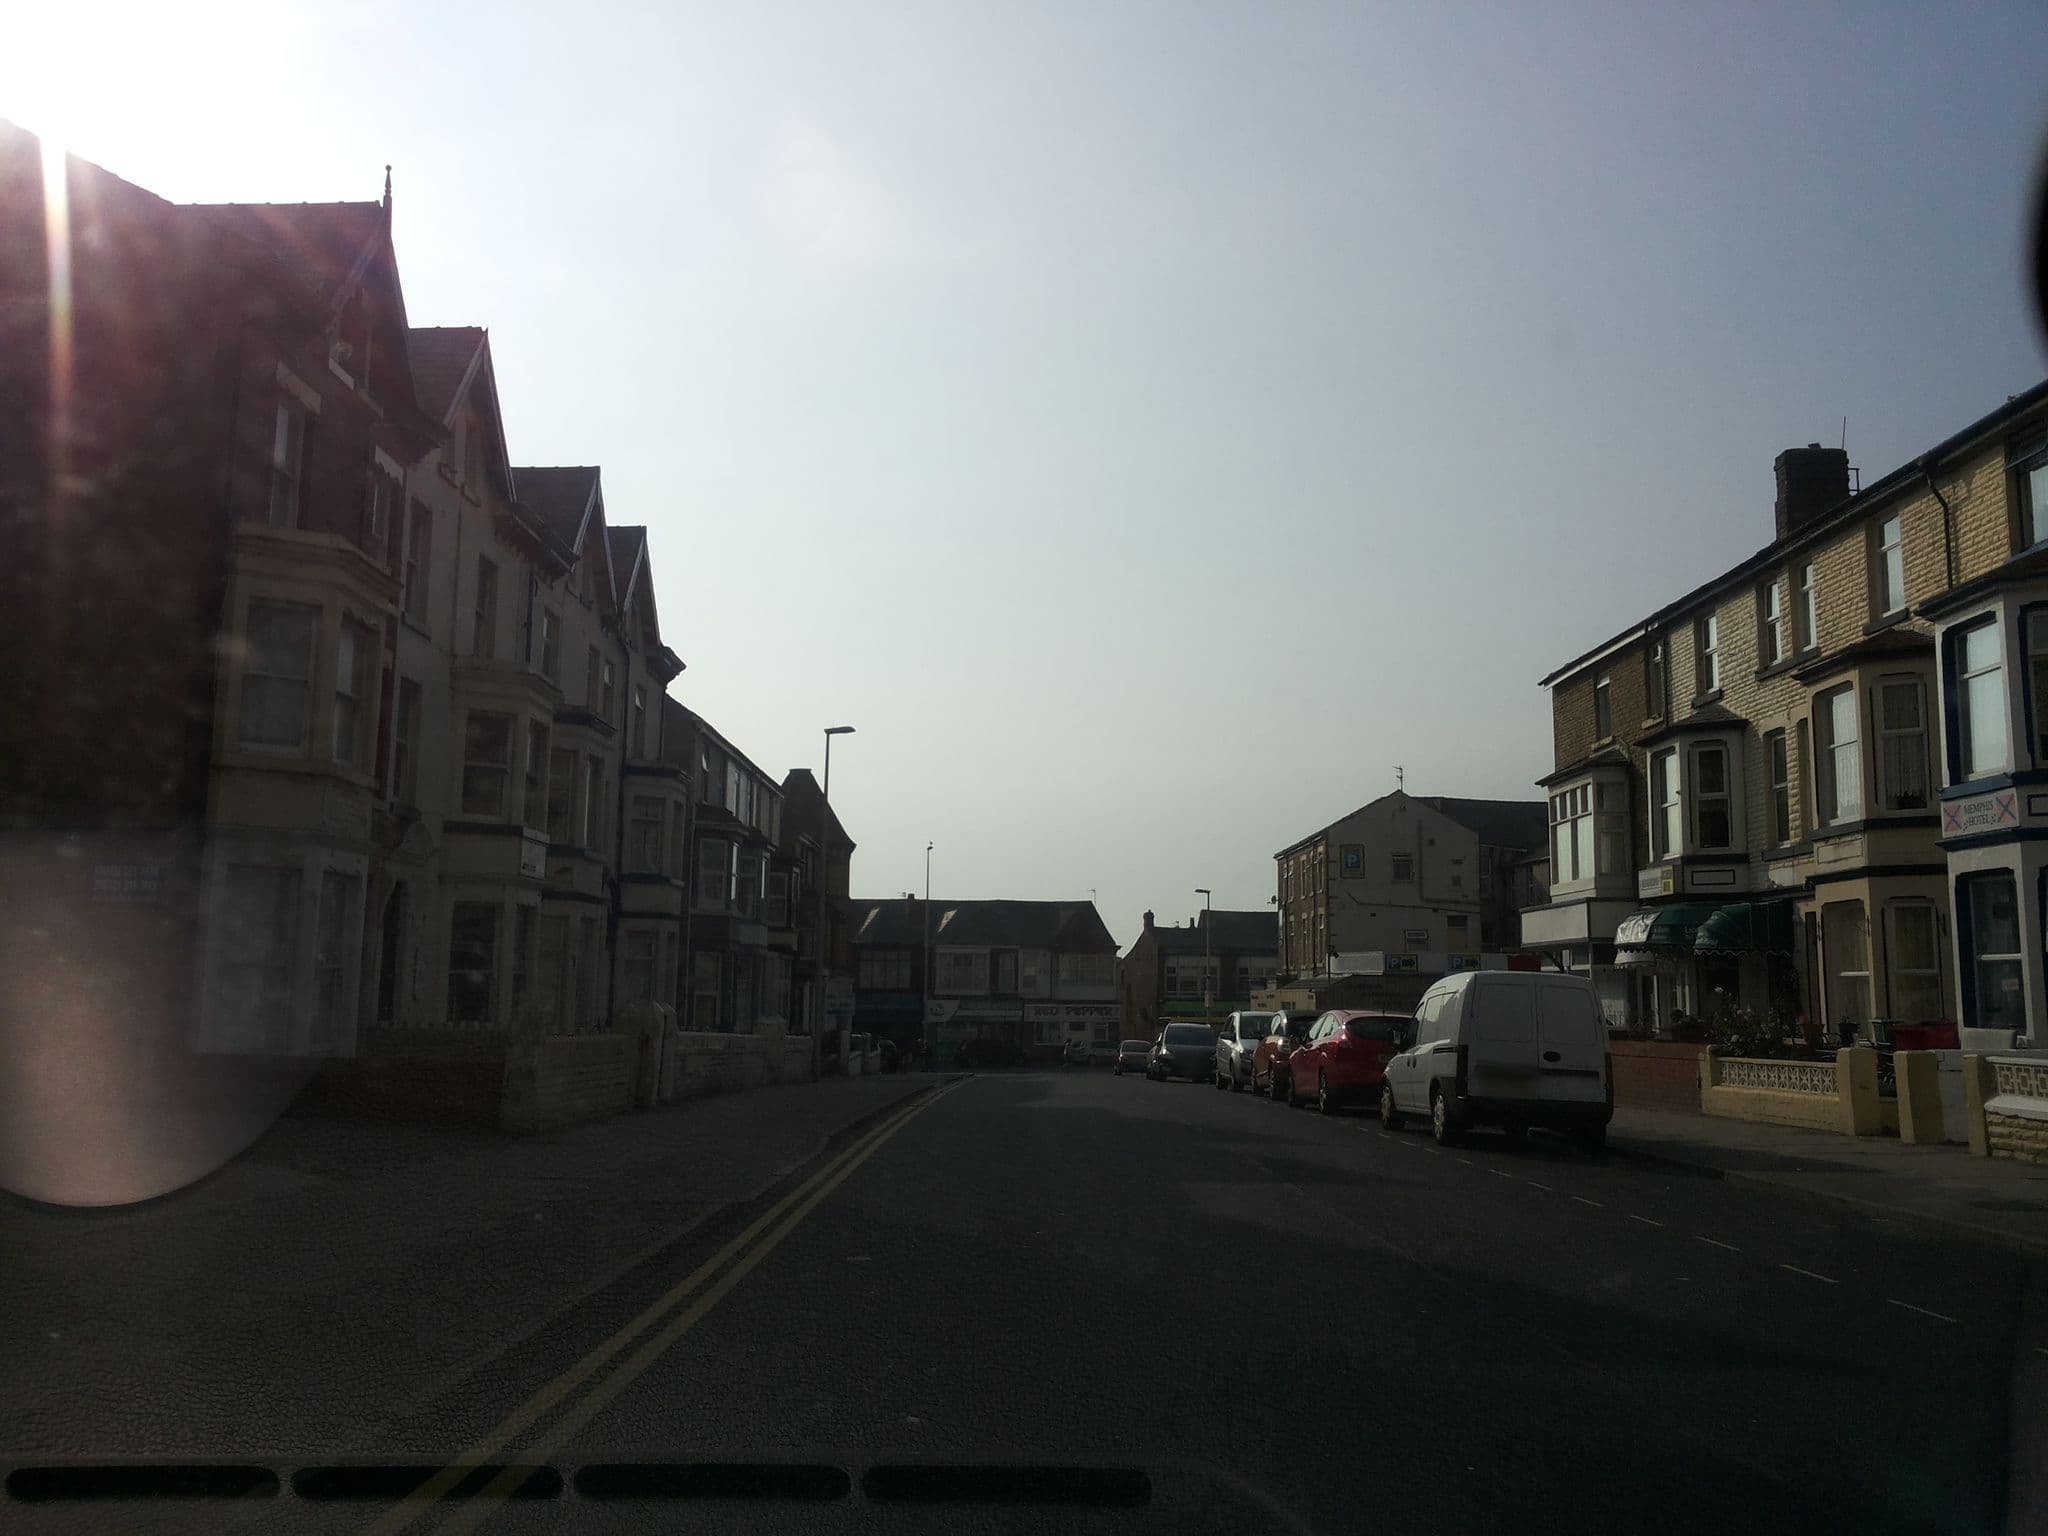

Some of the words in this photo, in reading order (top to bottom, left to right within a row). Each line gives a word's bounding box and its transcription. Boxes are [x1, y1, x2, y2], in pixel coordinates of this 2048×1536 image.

[1964, 800, 1994, 814] MEMPHIS
[1968, 814, 1991, 826] HOTEL
[1347, 854, 1357, 867] P
[1391, 958, 1399, 968] P
